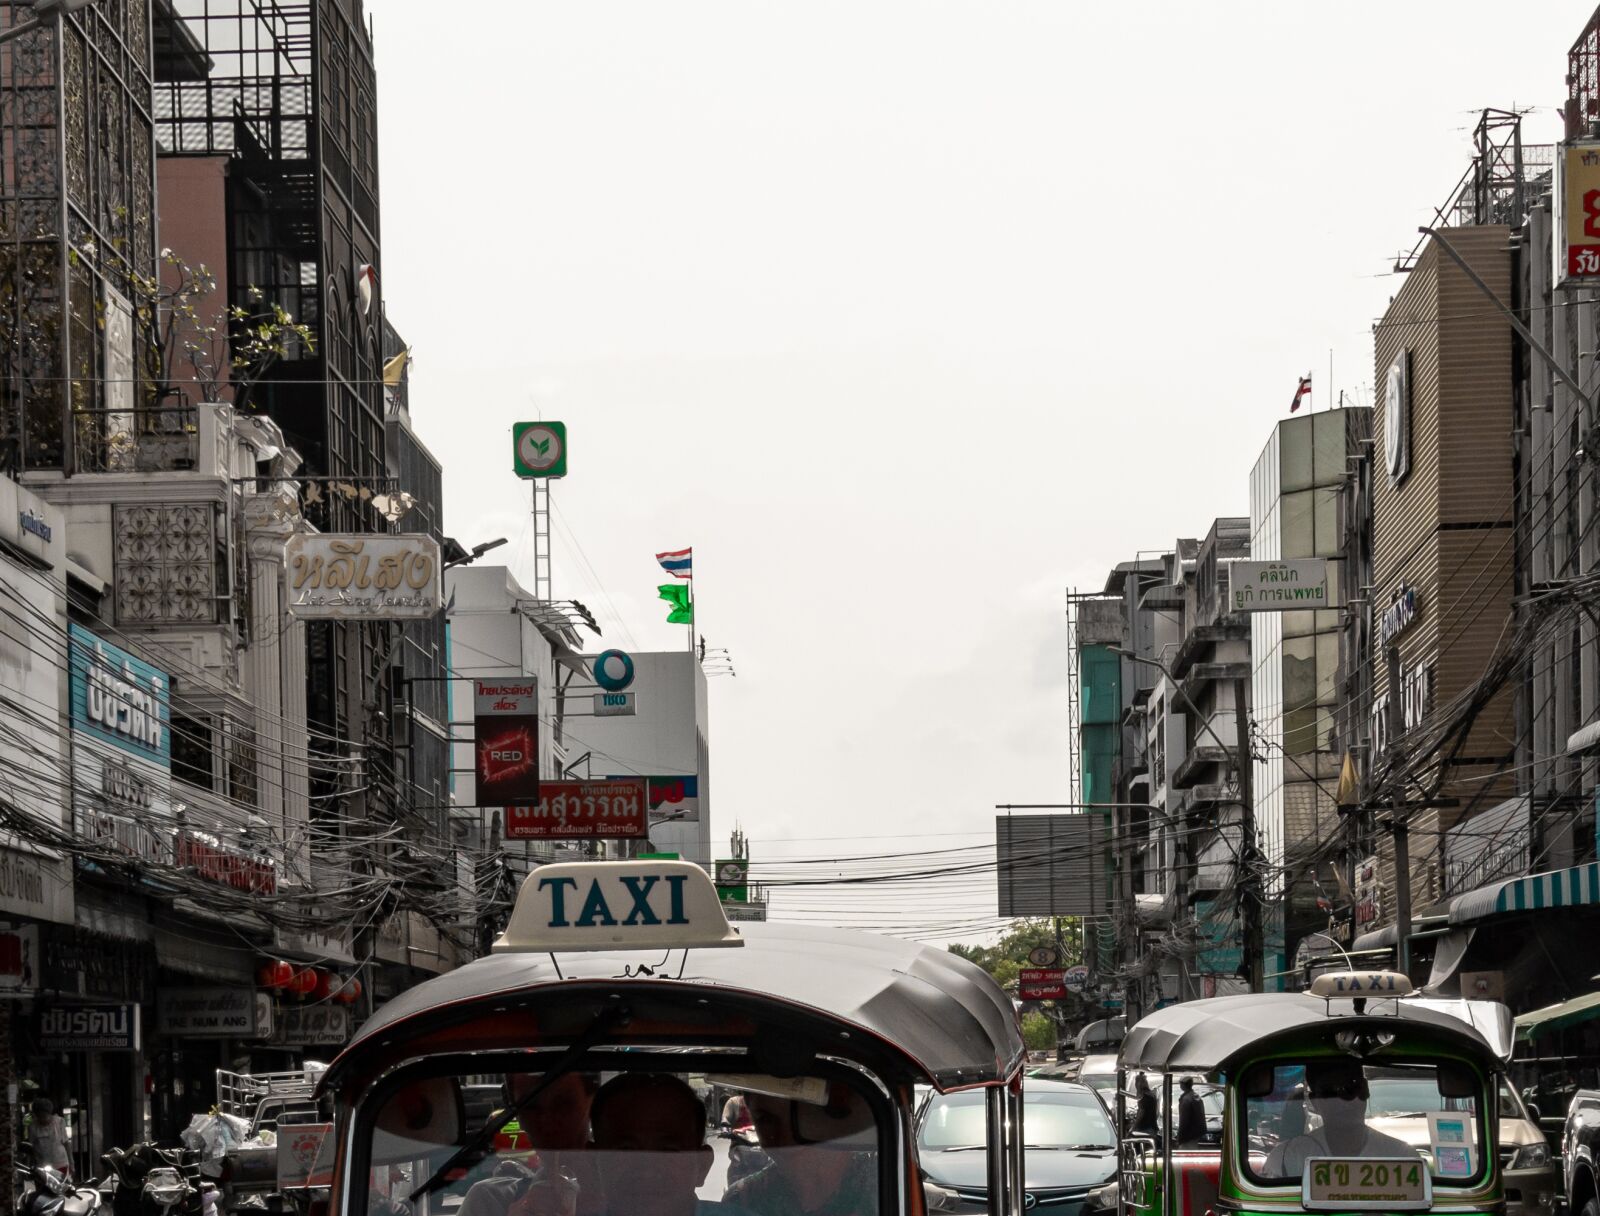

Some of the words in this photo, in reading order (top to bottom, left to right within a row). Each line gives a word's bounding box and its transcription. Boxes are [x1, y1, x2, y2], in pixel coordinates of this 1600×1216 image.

[1260, 580, 1325, 602] การแพทย์
[603, 694, 626, 706] TISCO
[491, 751, 522, 762] RED
[538, 874, 690, 928] TAXI
[1333, 975, 1395, 991] TAXI
[223, 1017, 247, 1027] ANG
[509, 1135, 518, 1150] 7
[1359, 1164, 1420, 1187] 2014
